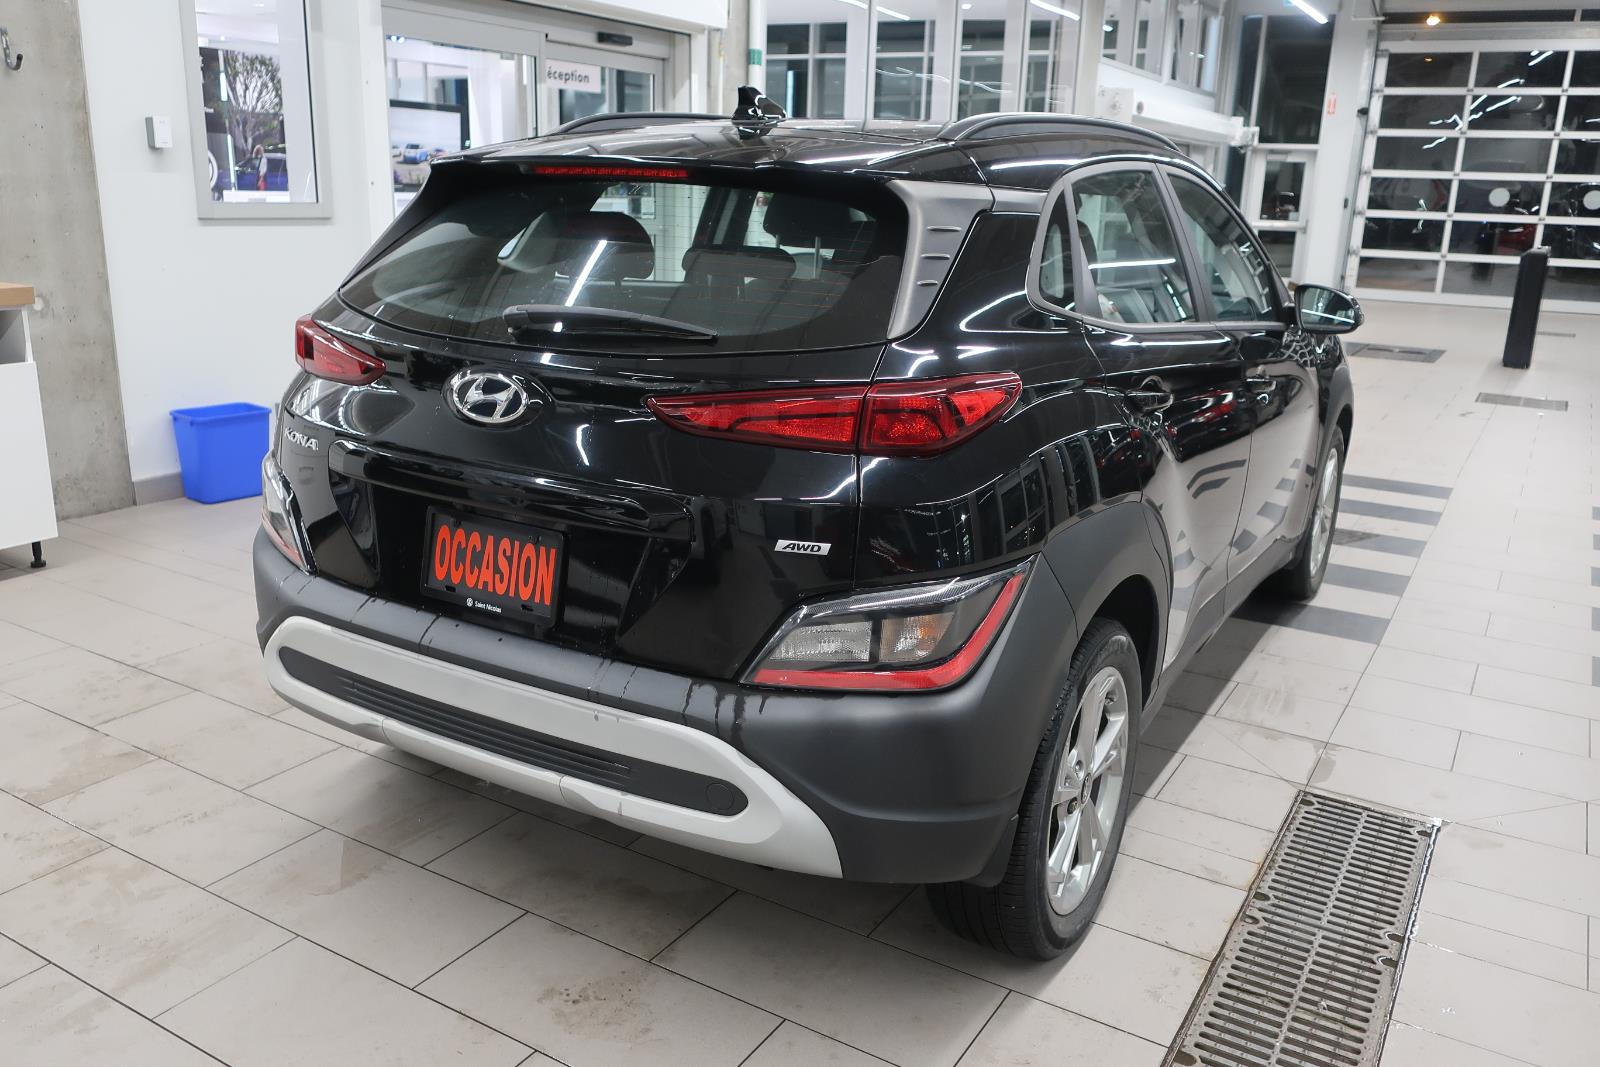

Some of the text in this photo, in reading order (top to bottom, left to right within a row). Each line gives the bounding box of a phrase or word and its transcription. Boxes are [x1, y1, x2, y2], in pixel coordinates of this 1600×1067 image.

[545, 66, 590, 84] éception
[284, 426, 319, 451] KONA
[782, 542, 822, 553] AWD
[435, 524, 557, 606] OCCASION
[474, 600, 502, 613] Saint Nicolas
